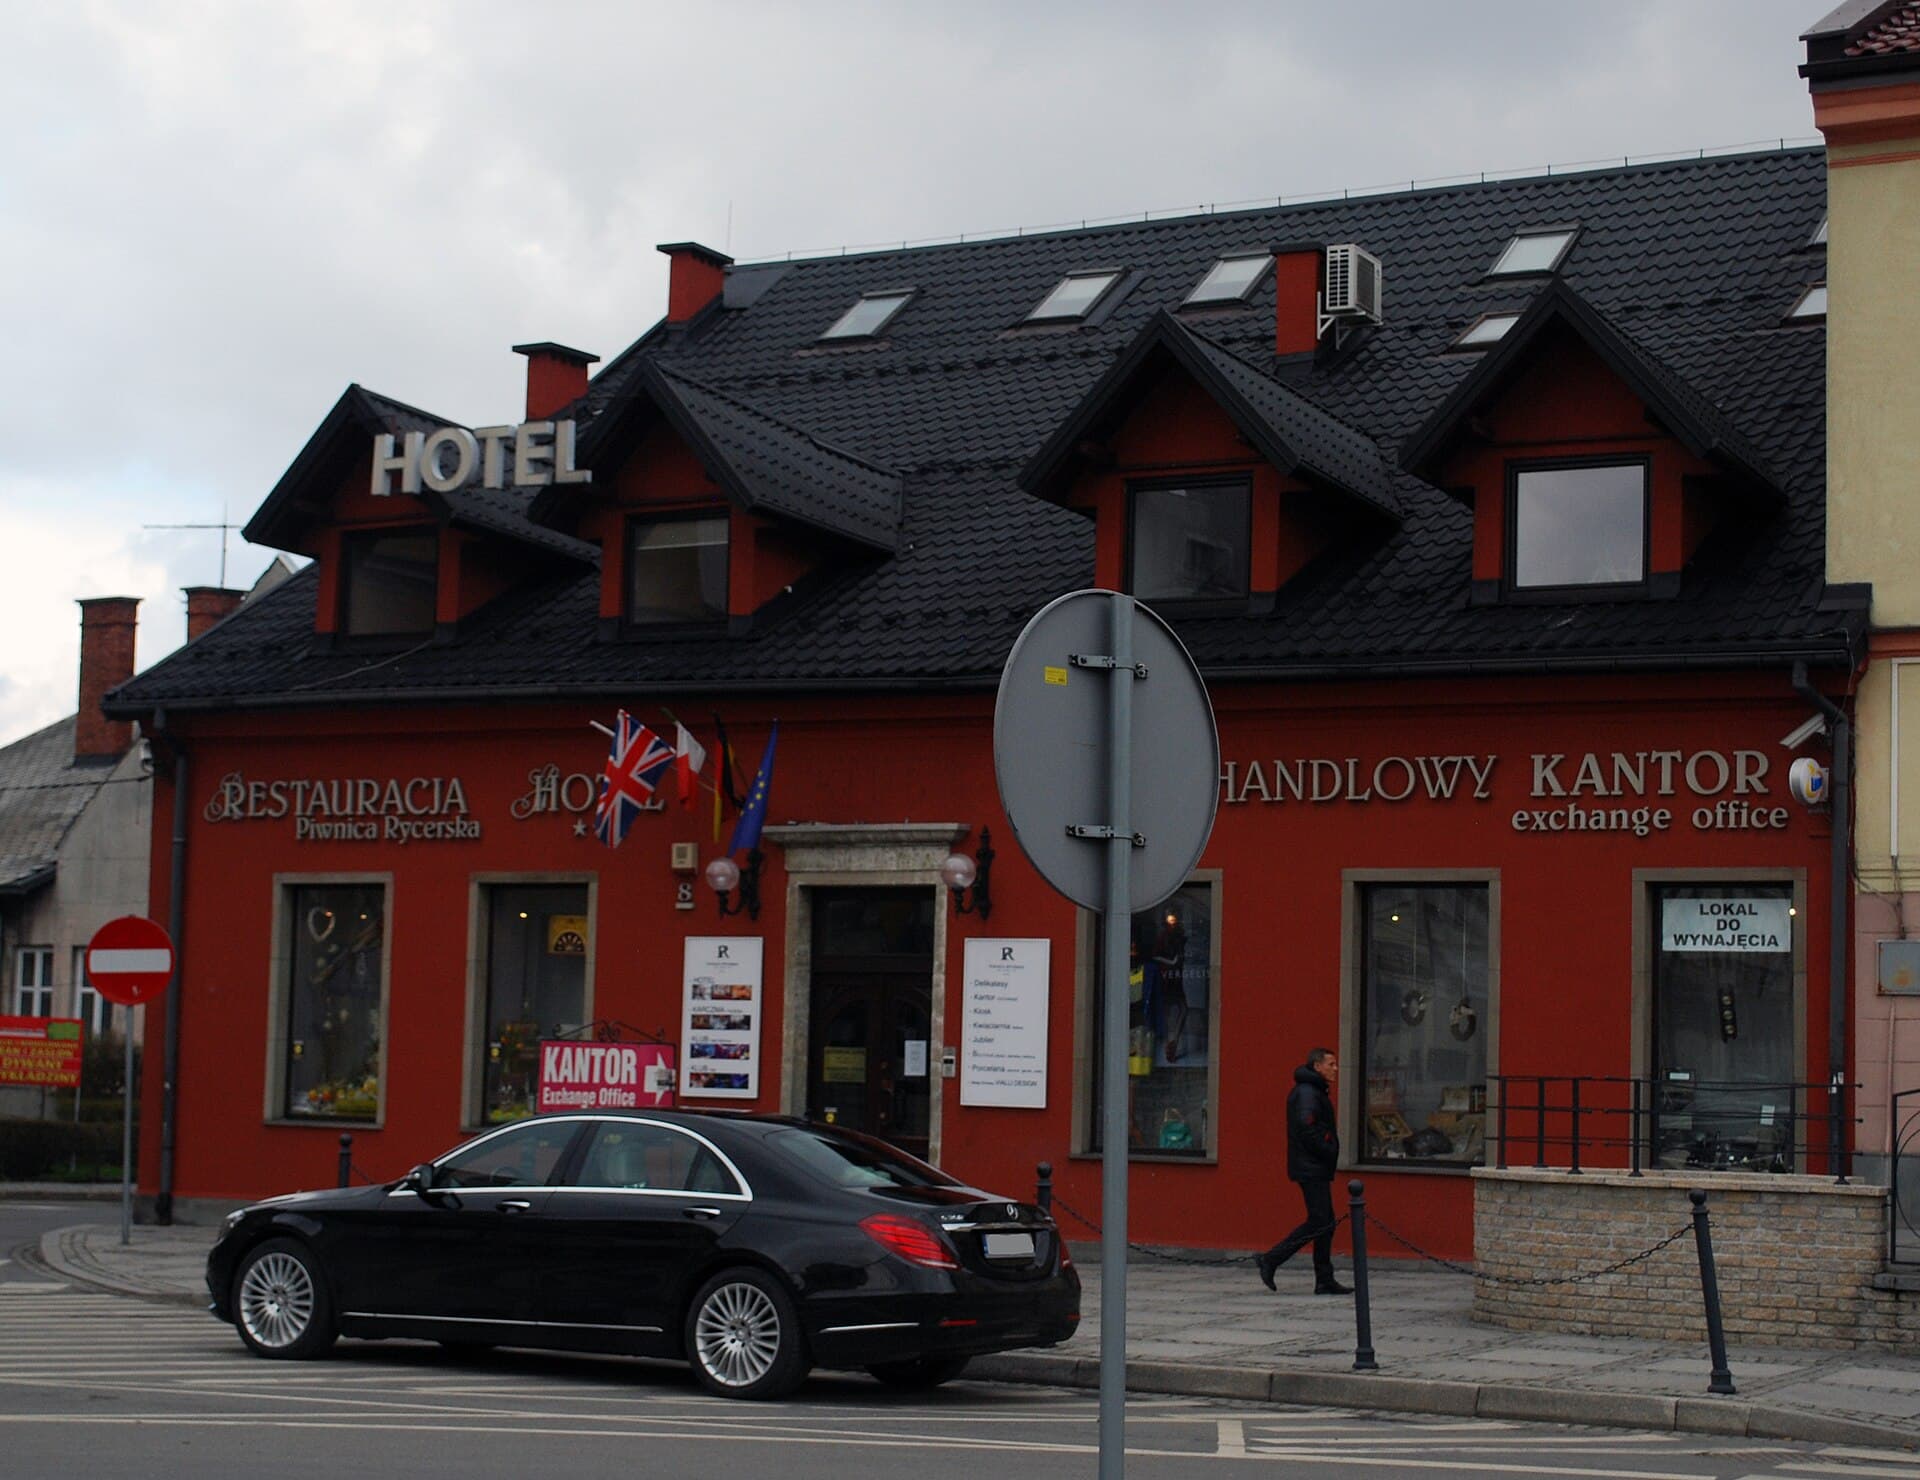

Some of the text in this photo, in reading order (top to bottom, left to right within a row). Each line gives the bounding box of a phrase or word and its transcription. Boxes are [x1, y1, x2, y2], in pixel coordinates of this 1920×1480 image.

[371, 419, 592, 496] HOTEL
[1530, 750, 1770, 797] KANTOR
[203, 771, 469, 822] RESTAURACJA
[296, 813, 481, 844] Piwnica Rycerska
[1511, 800, 1789, 836] exchange office
[677, 883, 692, 901] 8
[1700, 903, 1759, 916] LOKAL
[1716, 919, 1741, 931] DO
[1673, 934, 1780, 950] WYNAJĘCIA
[543, 1045, 638, 1085] KANTOR
[542, 1087, 637, 1108] Exchange Office
